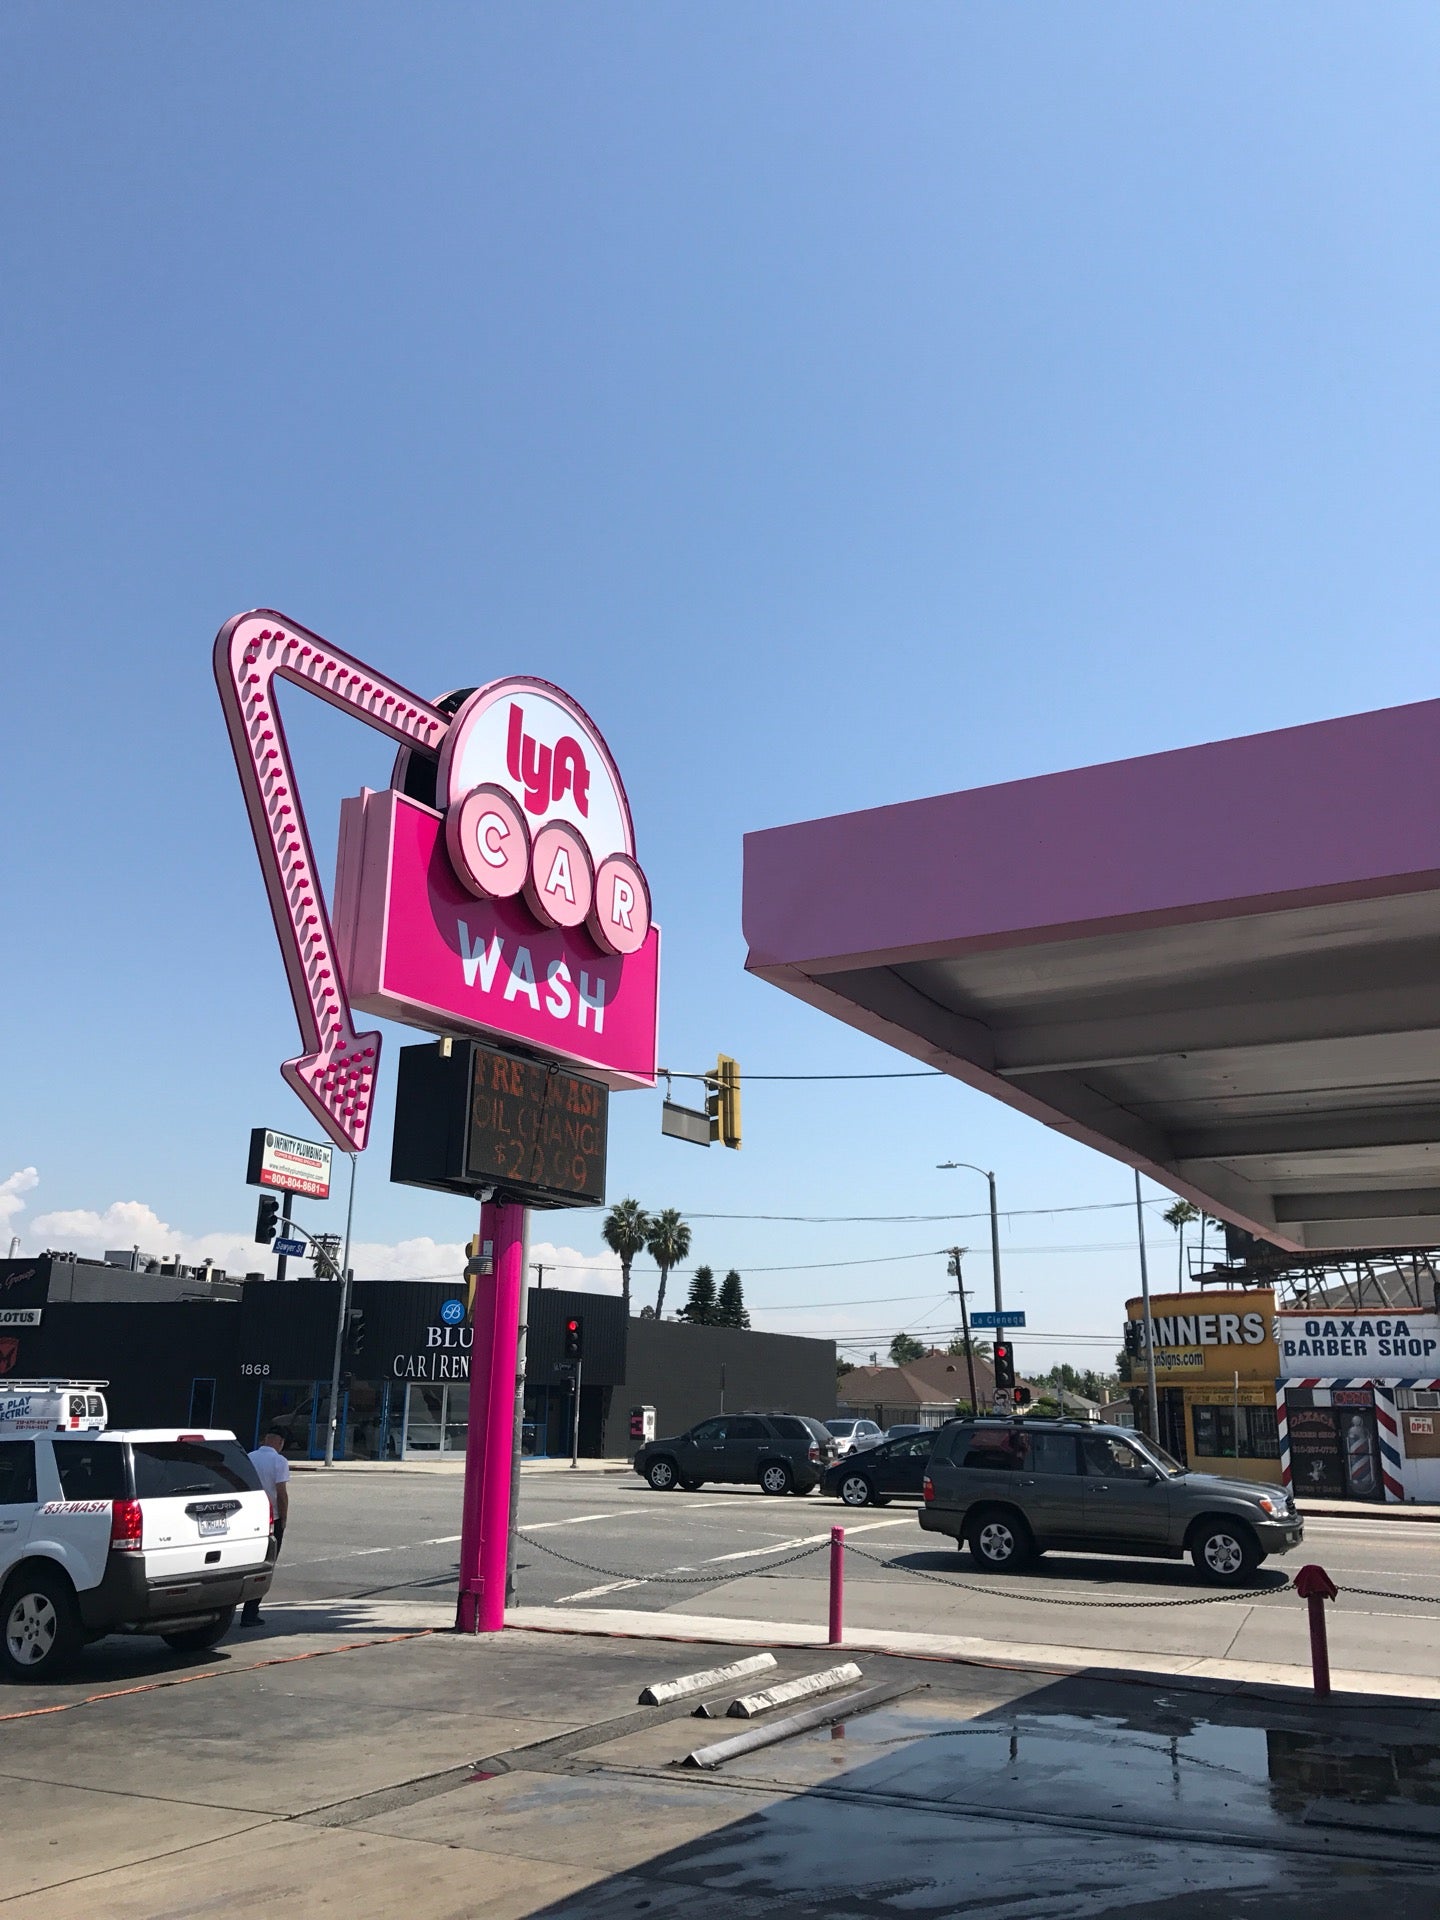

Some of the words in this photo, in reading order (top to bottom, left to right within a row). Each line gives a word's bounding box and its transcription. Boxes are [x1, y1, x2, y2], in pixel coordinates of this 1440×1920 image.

[506, 702, 590, 818] lyft
[476, 811, 634, 932] CAR
[457, 918, 605, 1034] WASH
[474, 1095, 510, 1134] OIL
[274, 1136, 296, 1153] INFINITY
[296, 1142, 322, 1161] PLUMBING
[971, 1316, 983, 1325] La
[1305, 1320, 1410, 1337] OAXACA
[1284, 1339, 1367, 1357] BARBER
[1378, 1338, 1437, 1357] SHOP
[240, 1364, 270, 1375] 1868
[393, 1354, 427, 1377] CAR
[8, 1396, 32, 1410] PLAY
[1411, 1423, 1432, 1433] OPEN
[44, 1501, 110, 1515] 837-WASH
[195, 1502, 236, 1512] SATURN
